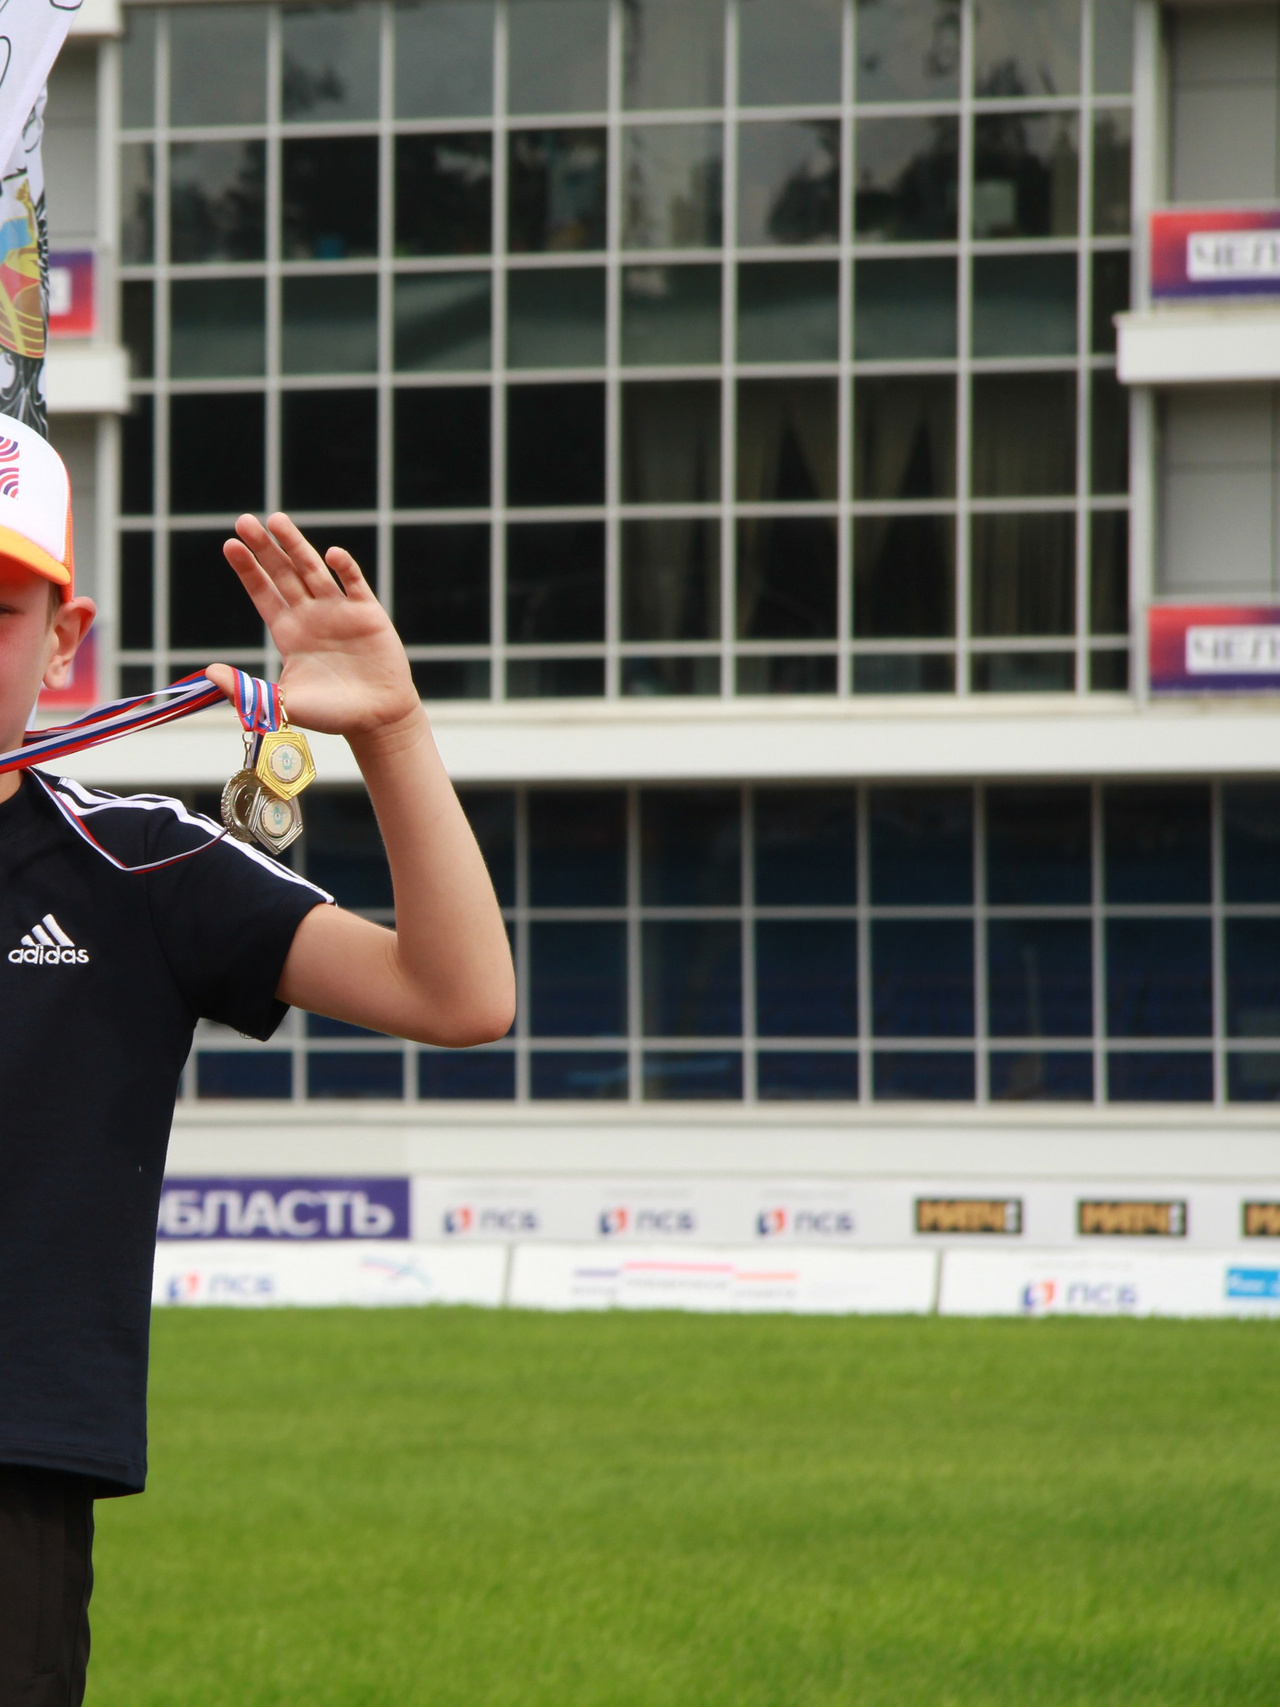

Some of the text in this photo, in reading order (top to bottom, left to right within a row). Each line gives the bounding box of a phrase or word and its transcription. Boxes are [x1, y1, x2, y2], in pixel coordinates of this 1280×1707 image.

[1195, 240, 1280, 267] ЧЕЛ
[1194, 637, 1280, 662] ЧЕЛ
[8, 944, 89, 965] adidas
[157, 1189, 395, 1237] БЛАСТЬ
